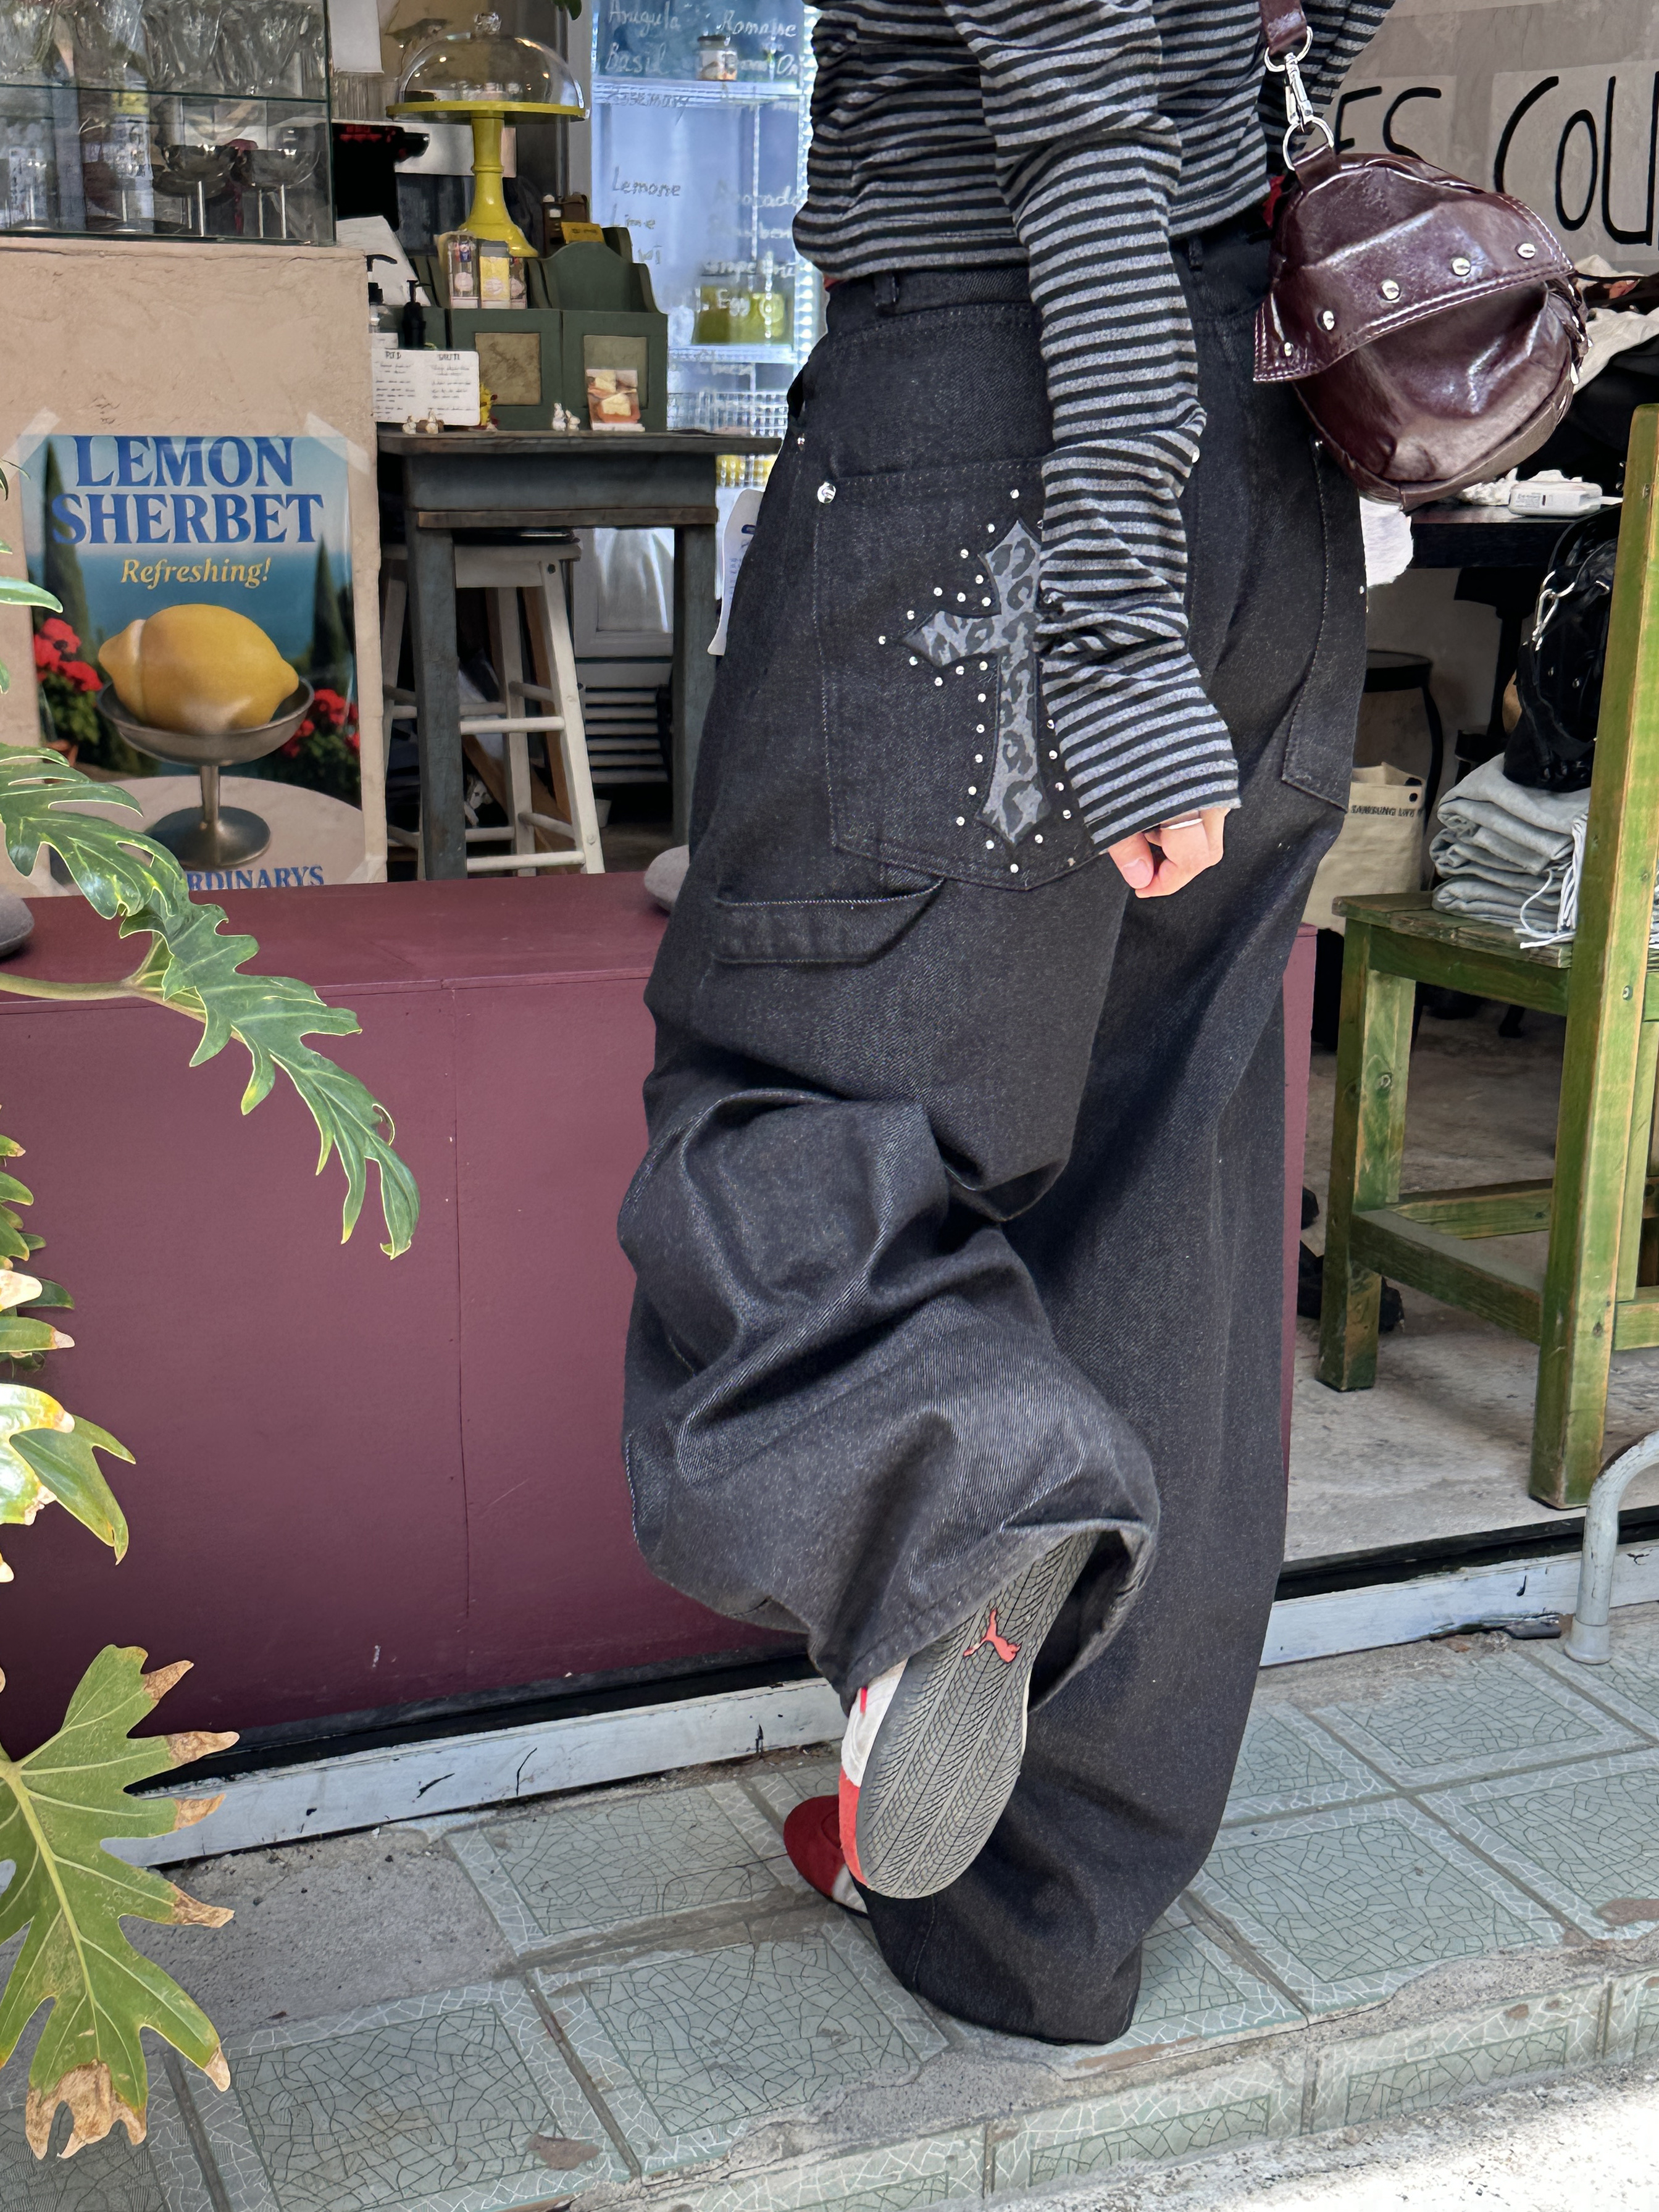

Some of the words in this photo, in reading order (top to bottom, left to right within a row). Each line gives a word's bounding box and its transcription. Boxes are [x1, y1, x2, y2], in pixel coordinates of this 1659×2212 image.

[1494, 70, 1659, 251] COU
[74, 435, 295, 488] LEMON
[52, 493, 324, 545] SHERBET
[120, 557, 272, 589] Refreshing!
[186, 865, 325, 891] RDINARYS
